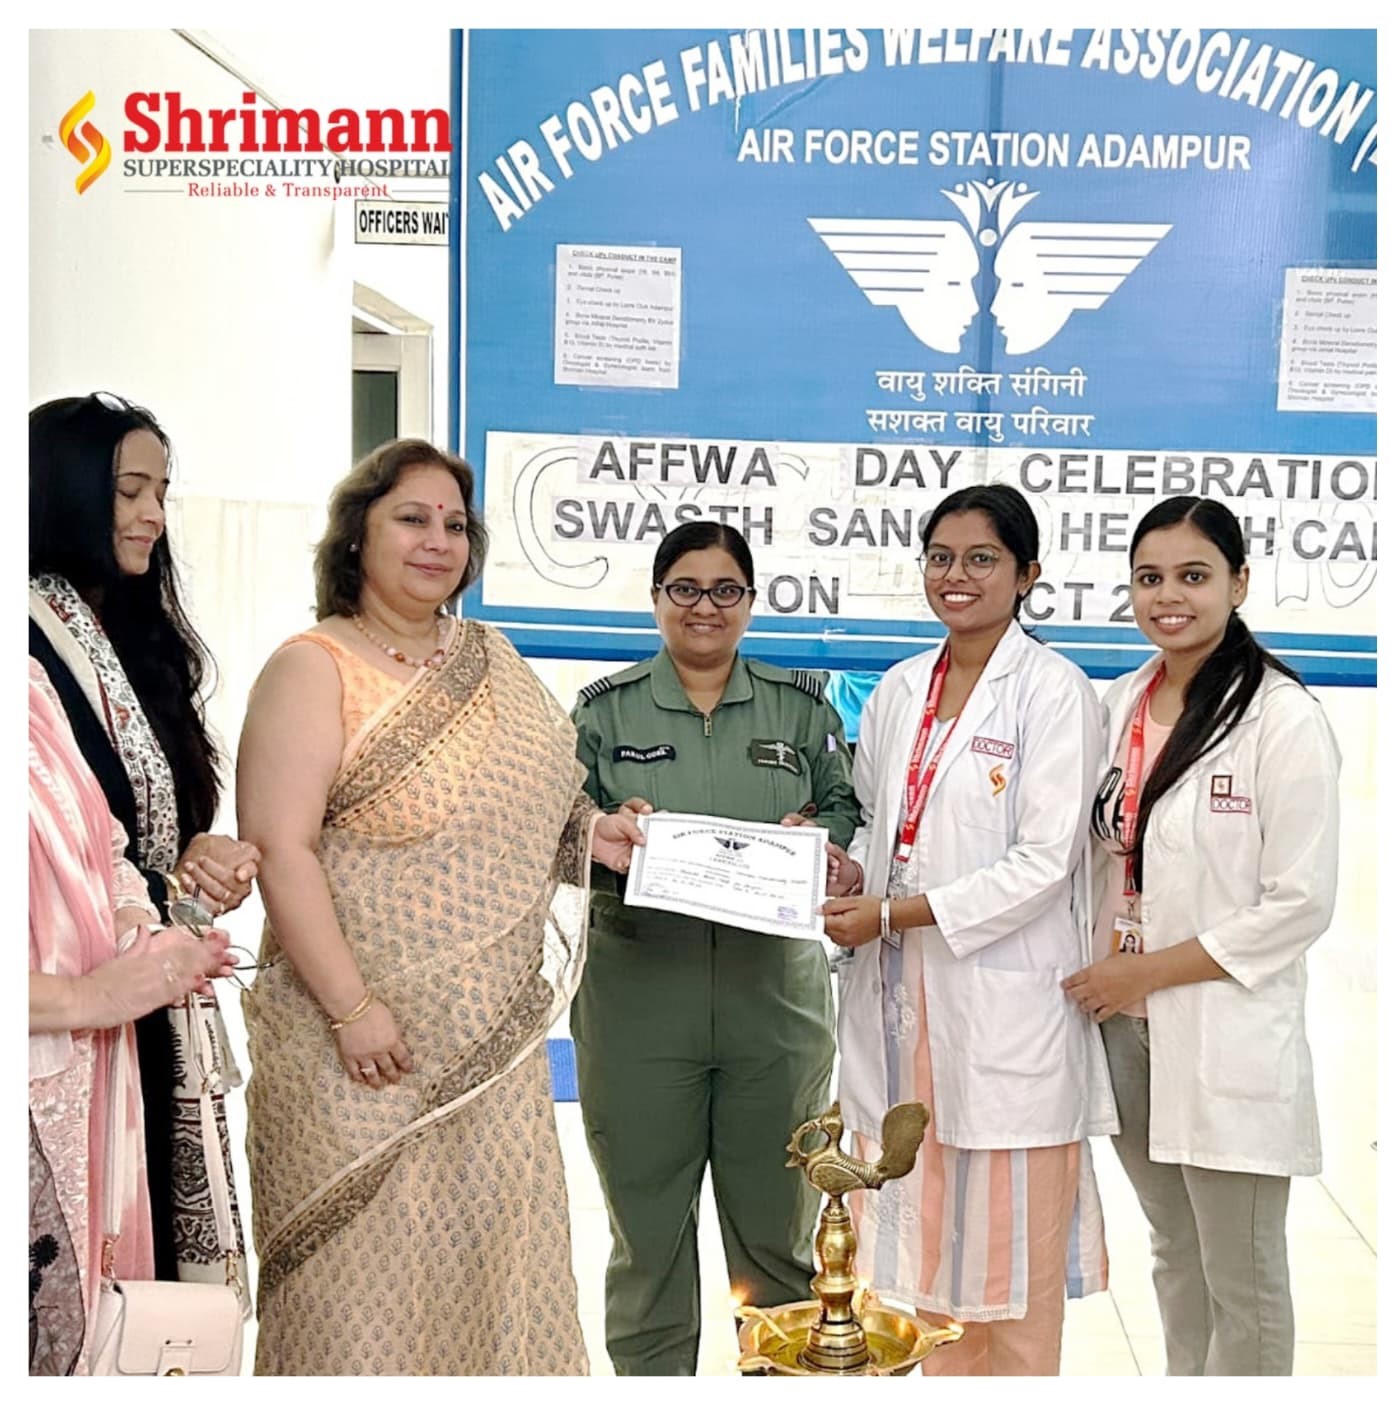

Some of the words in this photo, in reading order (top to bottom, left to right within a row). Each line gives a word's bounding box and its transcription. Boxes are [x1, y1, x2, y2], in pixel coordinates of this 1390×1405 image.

[477, 139, 556, 231] AIR
[544, 58, 680, 180] FORCE
[680, 29, 869, 112] FAMILIES
[1080, 29, 1375, 144] ASSOCIATION
[737, 128, 795, 163] AIR
[804, 130, 920, 165] FORCE
[928, 131, 1070, 168] STATION
[1077, 133, 1252, 171] ADAMPUR
[359, 209, 419, 234] OFFICERS
[421, 210, 449, 235] WAI
[876, 370, 926, 401] वायु
[932, 365, 1003, 397] शक्ति
[1009, 366, 1088, 397] संगिनी
[866, 409, 948, 434] सशक्त
[954, 411, 1006, 443] वायु
[1011, 405, 1095, 437] परिवार
[590, 440, 778, 487] AFFWA
[855, 447, 963, 490] DAY
[1019, 453, 1377, 502] CELEBRATIO
[1292, 519, 1377, 562] CA
[768, 574, 840, 615] ON
[1023, 581, 1095, 622] CT
